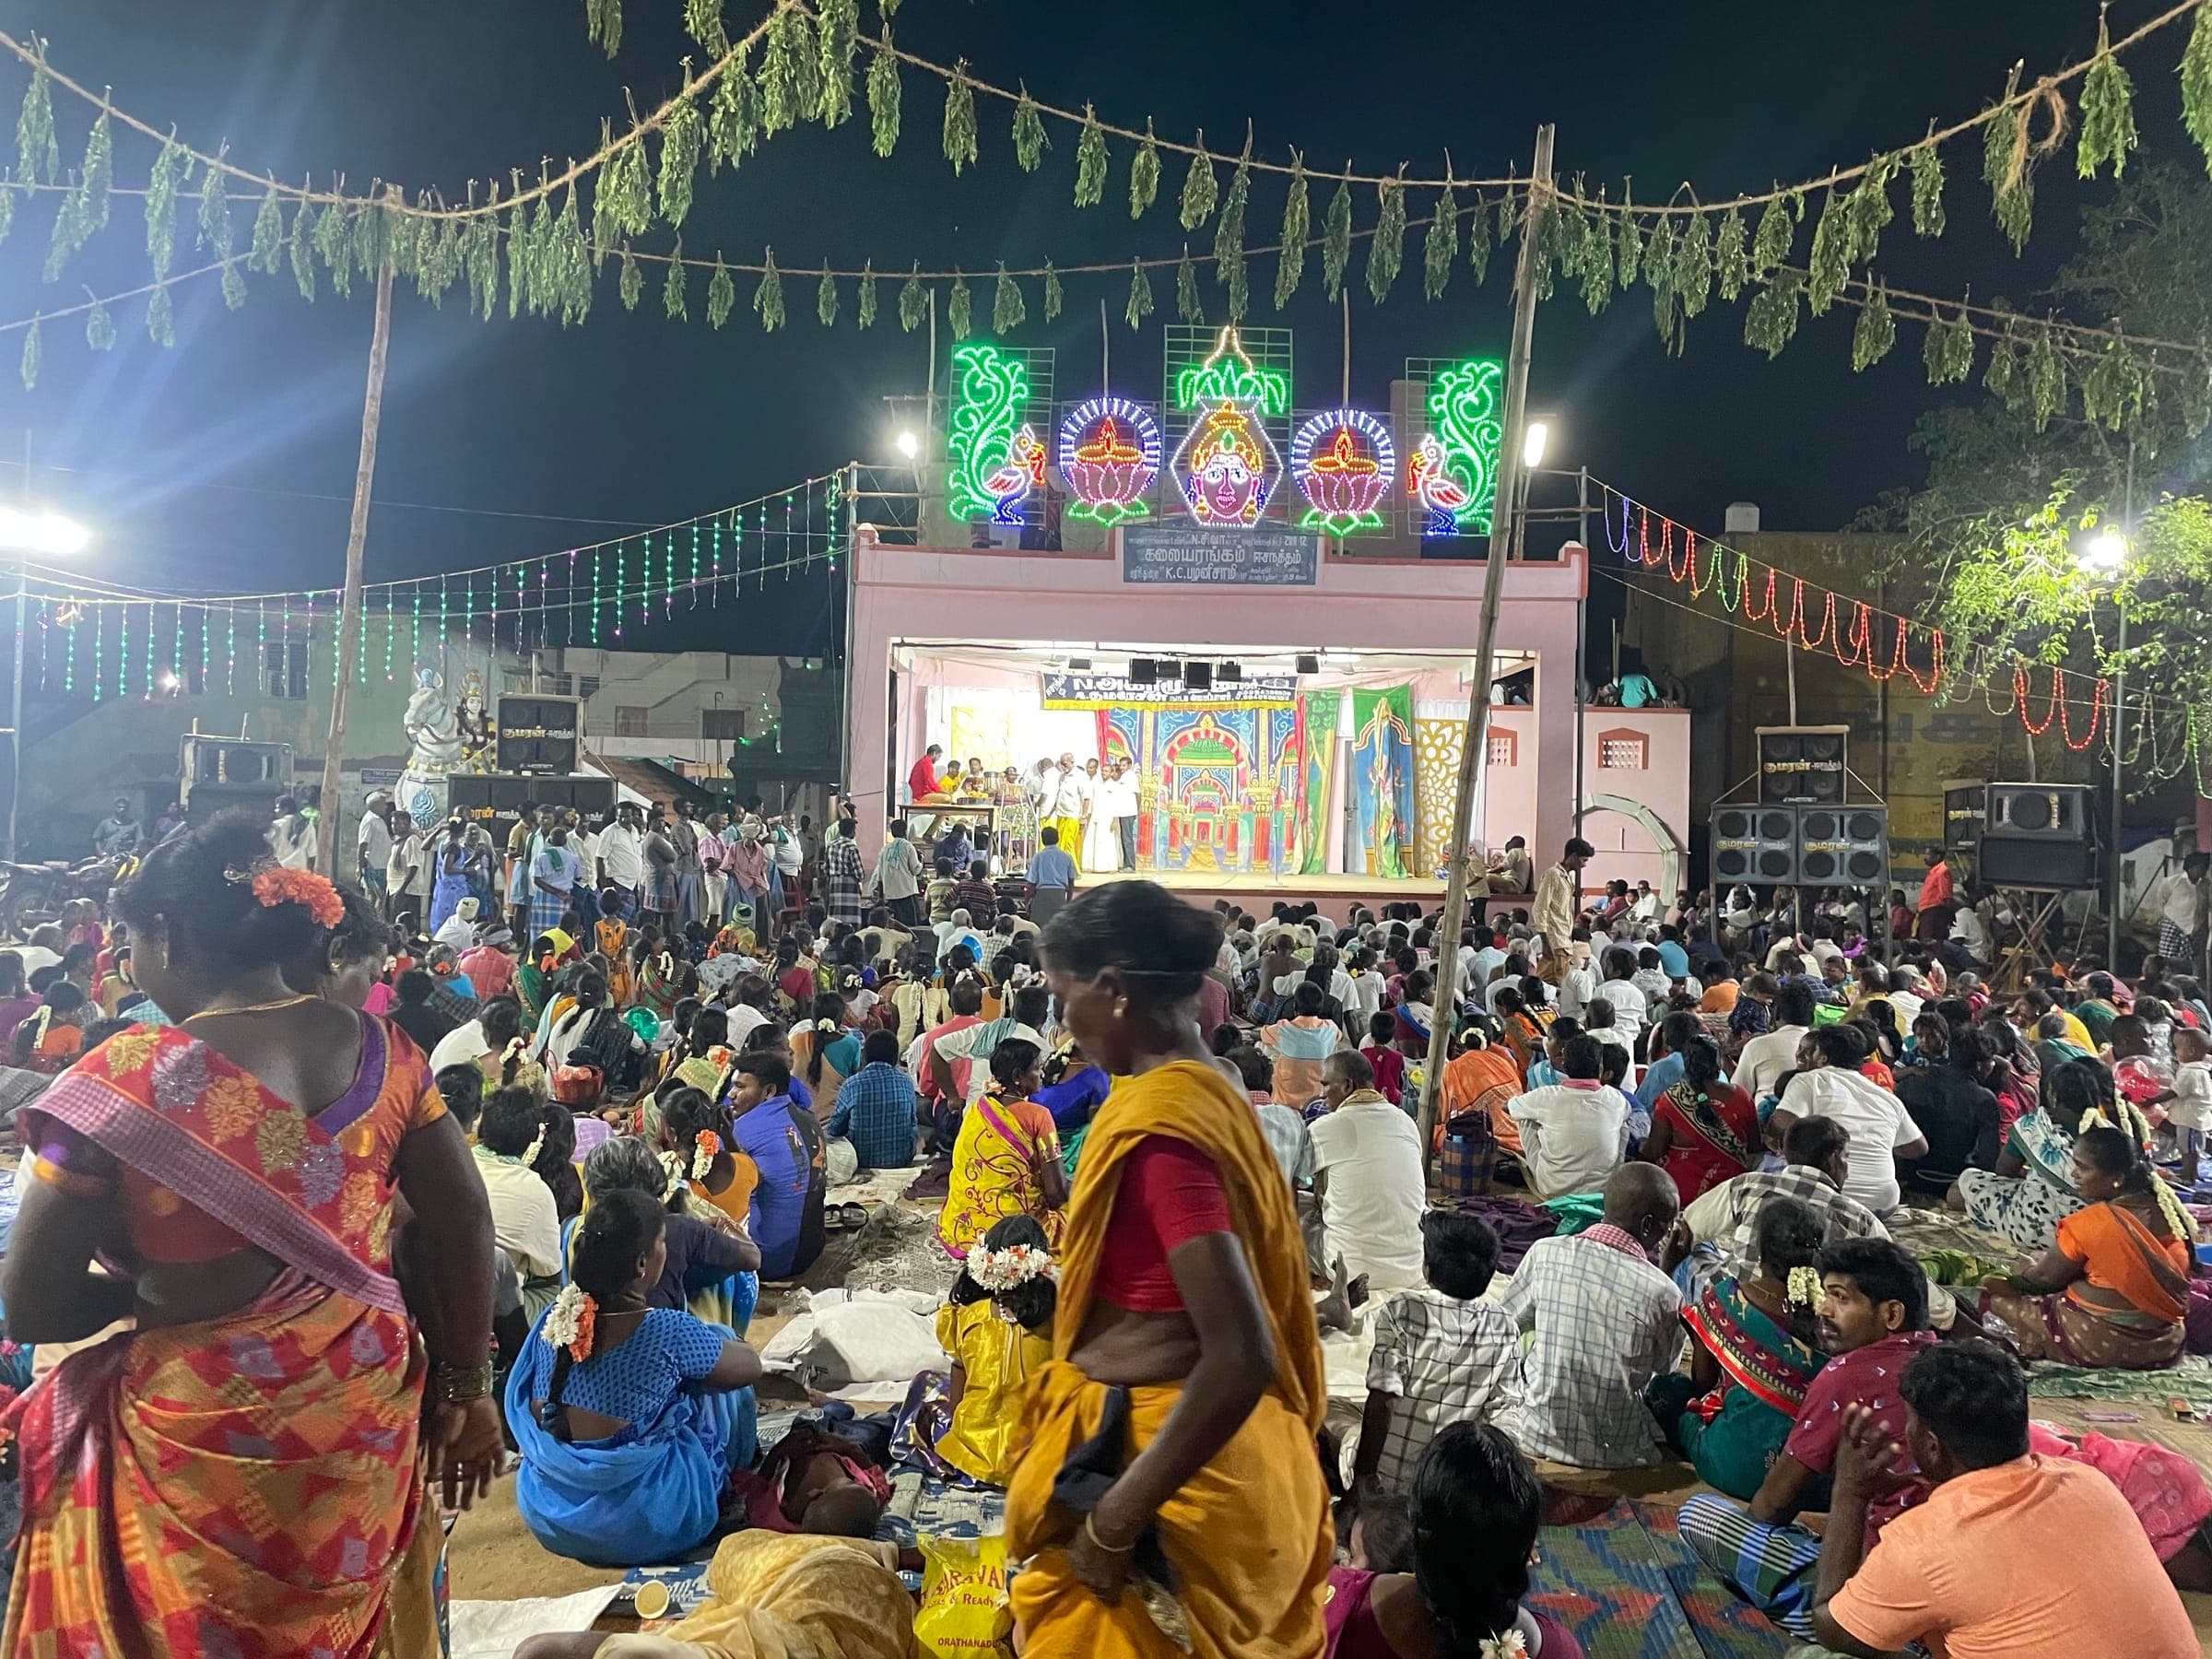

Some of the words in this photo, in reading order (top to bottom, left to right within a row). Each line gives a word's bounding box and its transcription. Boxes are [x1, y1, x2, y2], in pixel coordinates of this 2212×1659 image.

[1145, 546, 1245, 565] கலையரங்கம்
[1763, 758, 1811, 773] குமரன்
[1716, 837, 1759, 851] குமரன்
[1805, 838, 1851, 853] குமரன்
